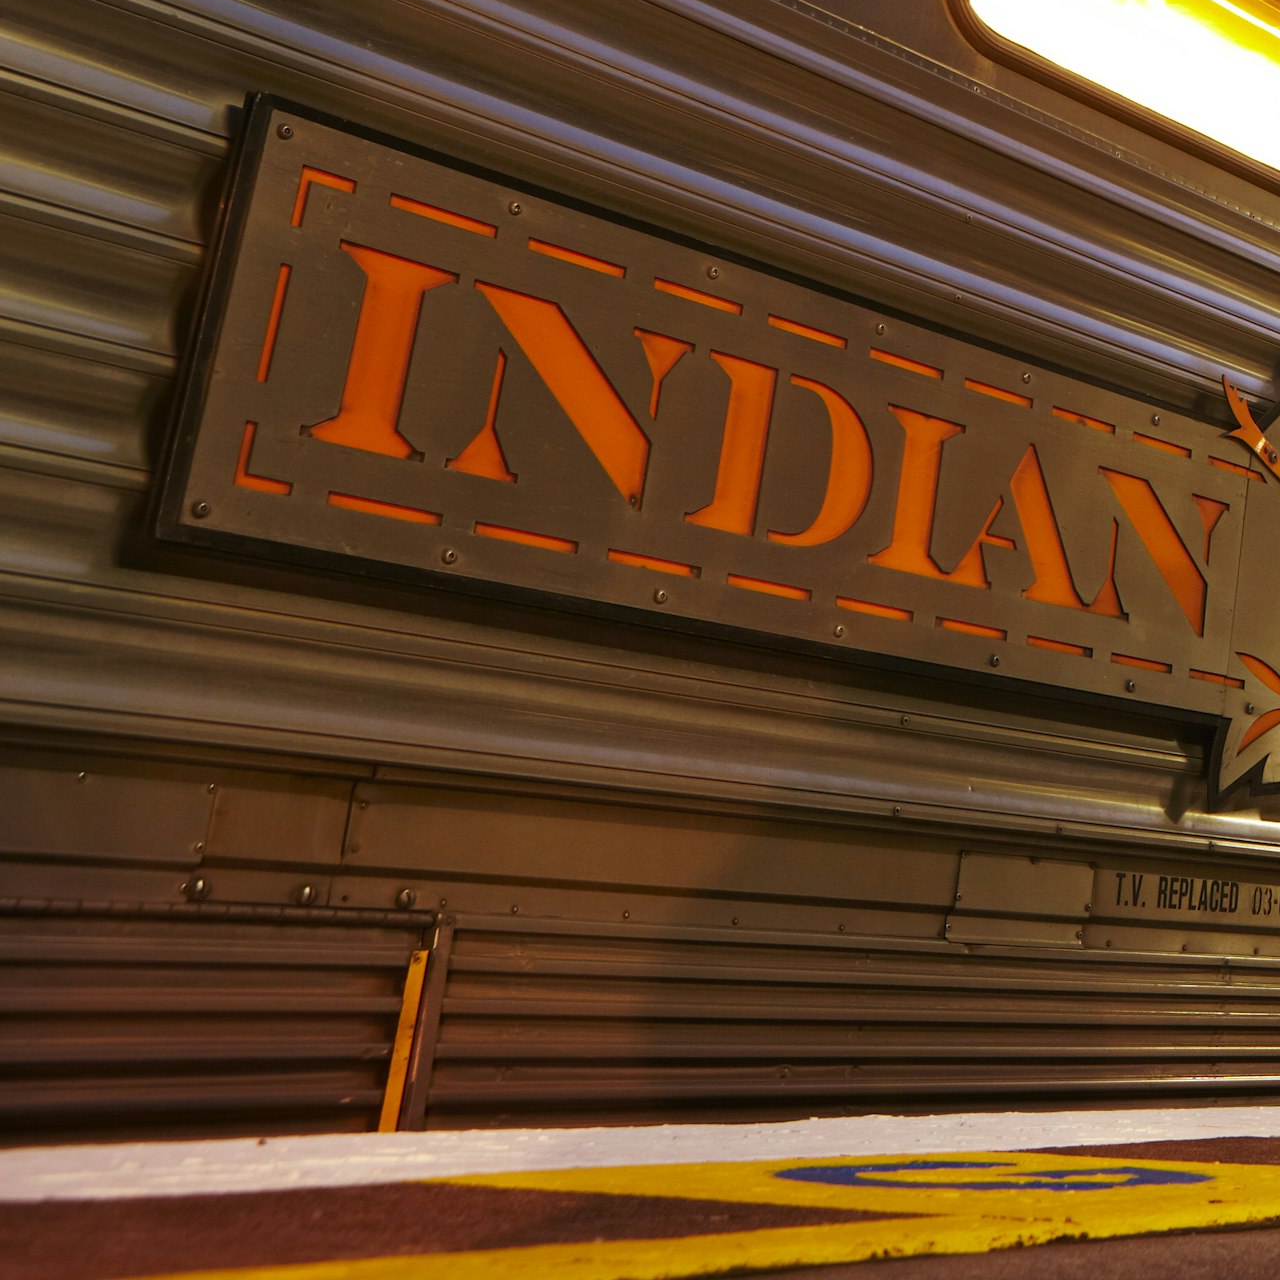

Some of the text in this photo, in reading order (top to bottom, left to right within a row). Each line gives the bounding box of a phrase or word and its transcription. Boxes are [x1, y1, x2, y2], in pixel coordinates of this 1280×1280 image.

[301, 241, 1230, 637] INDIAN
[1116, 873, 1146, 908] T.V.
[1157, 876, 1240, 913] REPLACED
